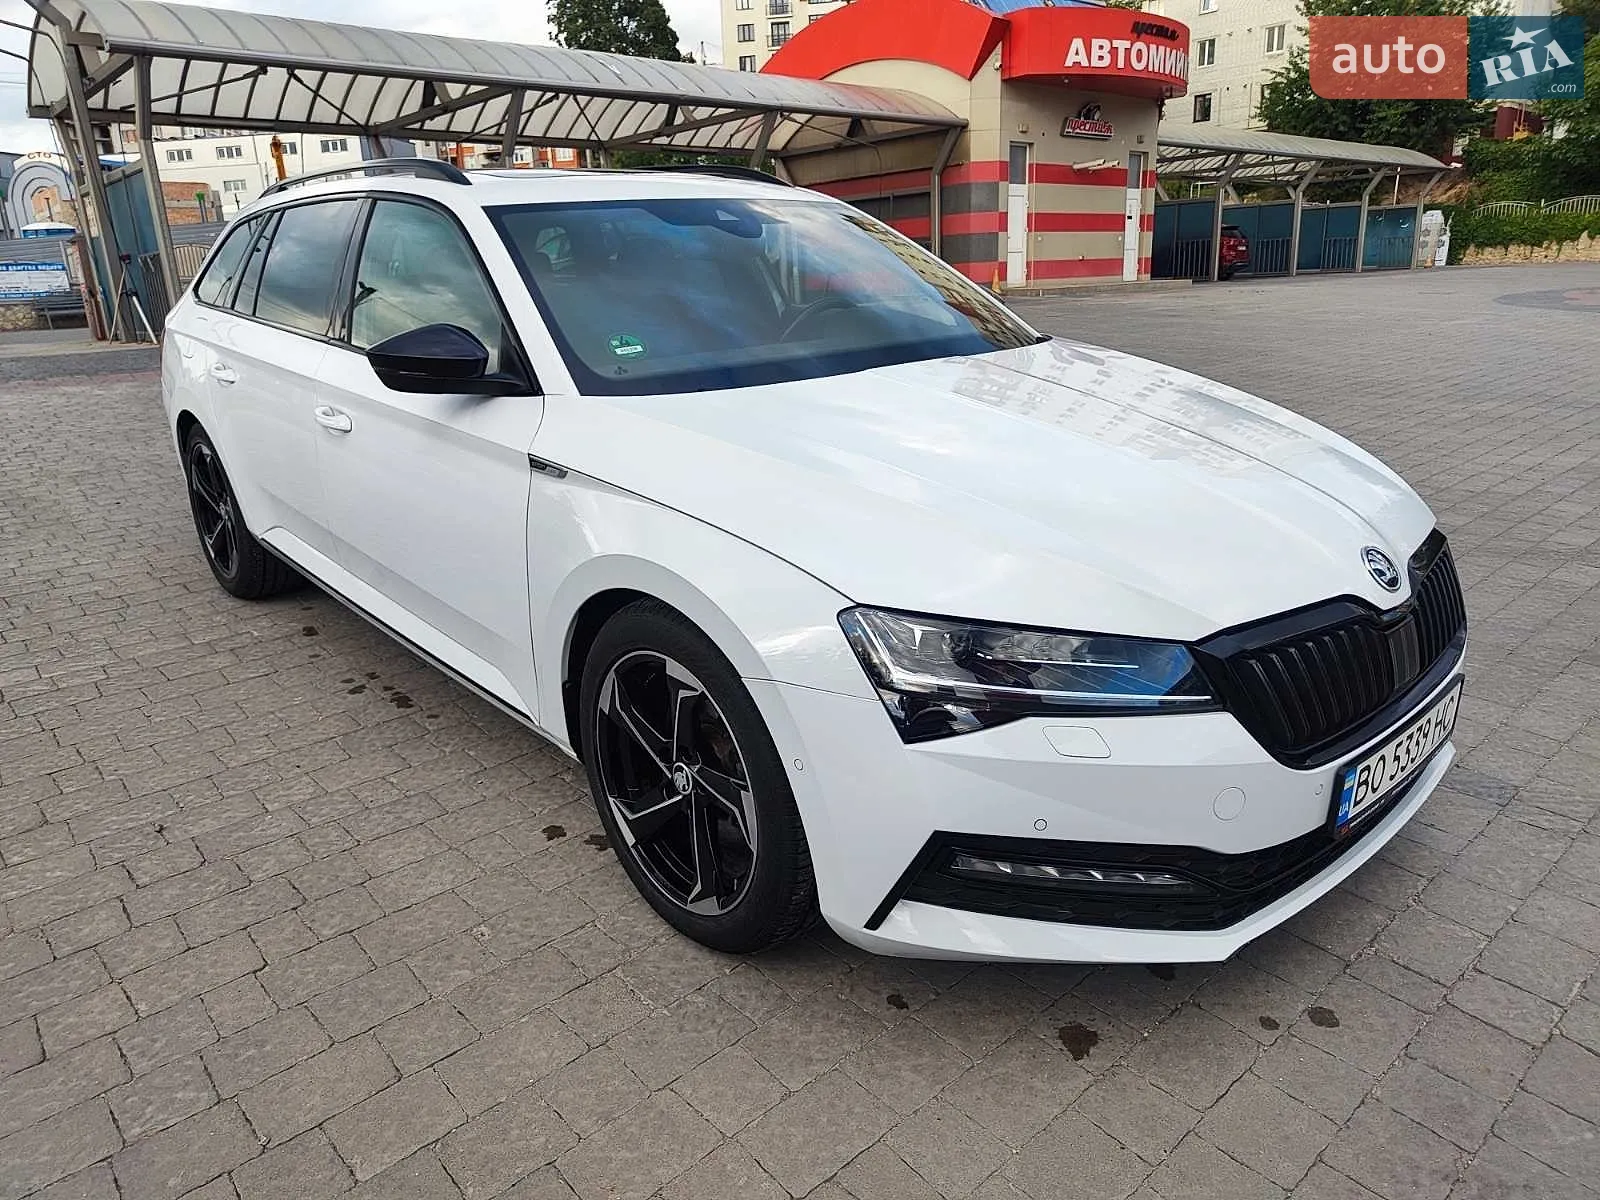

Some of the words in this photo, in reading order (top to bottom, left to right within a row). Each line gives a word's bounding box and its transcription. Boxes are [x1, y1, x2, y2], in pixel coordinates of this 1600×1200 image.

[1352, 754, 1386, 809] BO
[1389, 717, 1432, 782] 5339
[1431, 695, 1455, 745] HC
